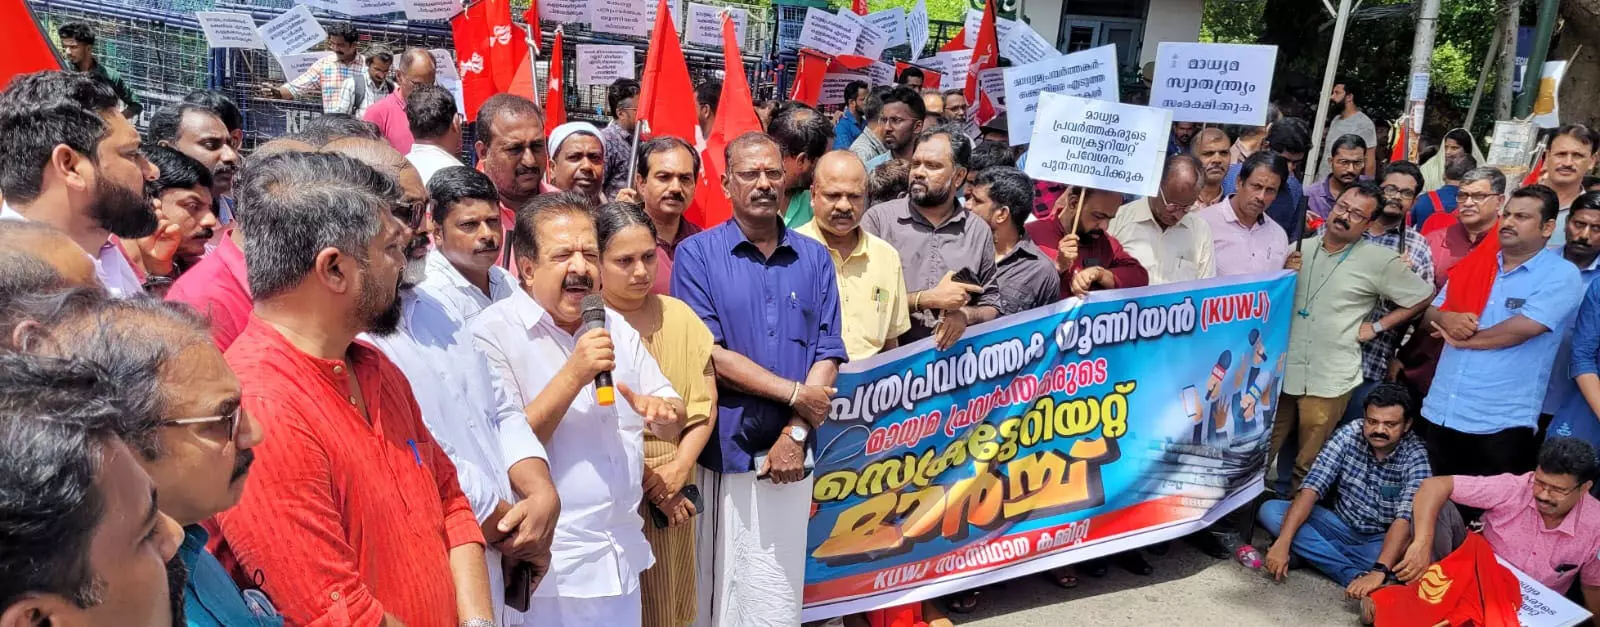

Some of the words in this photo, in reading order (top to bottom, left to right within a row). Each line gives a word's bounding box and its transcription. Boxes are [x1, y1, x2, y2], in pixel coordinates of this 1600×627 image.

[1188, 58, 1240, 76] മാധ്യമ
[1166, 77, 1256, 96] സ്വാതന്ത്ര്യം
[1085, 111, 1120, 125] മാധ്യമ
[1162, 99, 1253, 115] സംരക്ഷിക്കുക
[1053, 119, 1147, 142] പ്രവർത്തകരുടെ
[1060, 134, 1139, 157] സെക്രട്ടറിയറ്റ്
[1066, 149, 1124, 166] പ്രവേശനം
[829, 331, 1045, 422] പത്രപ്രവർത്തക
[1055, 296, 1196, 355] യൂണിയൻ
[1201, 291, 1270, 332] (KUWJ)
[812, 380, 1137, 500] സെക്രട്ടേറിയറ്റ്
[865, 410, 942, 456] മാധ്യമ
[811, 437, 1115, 559] മാർച്ച്
[873, 560, 930, 590] KUWJ
[935, 536, 1030, 574] സംസ്ഥാന
